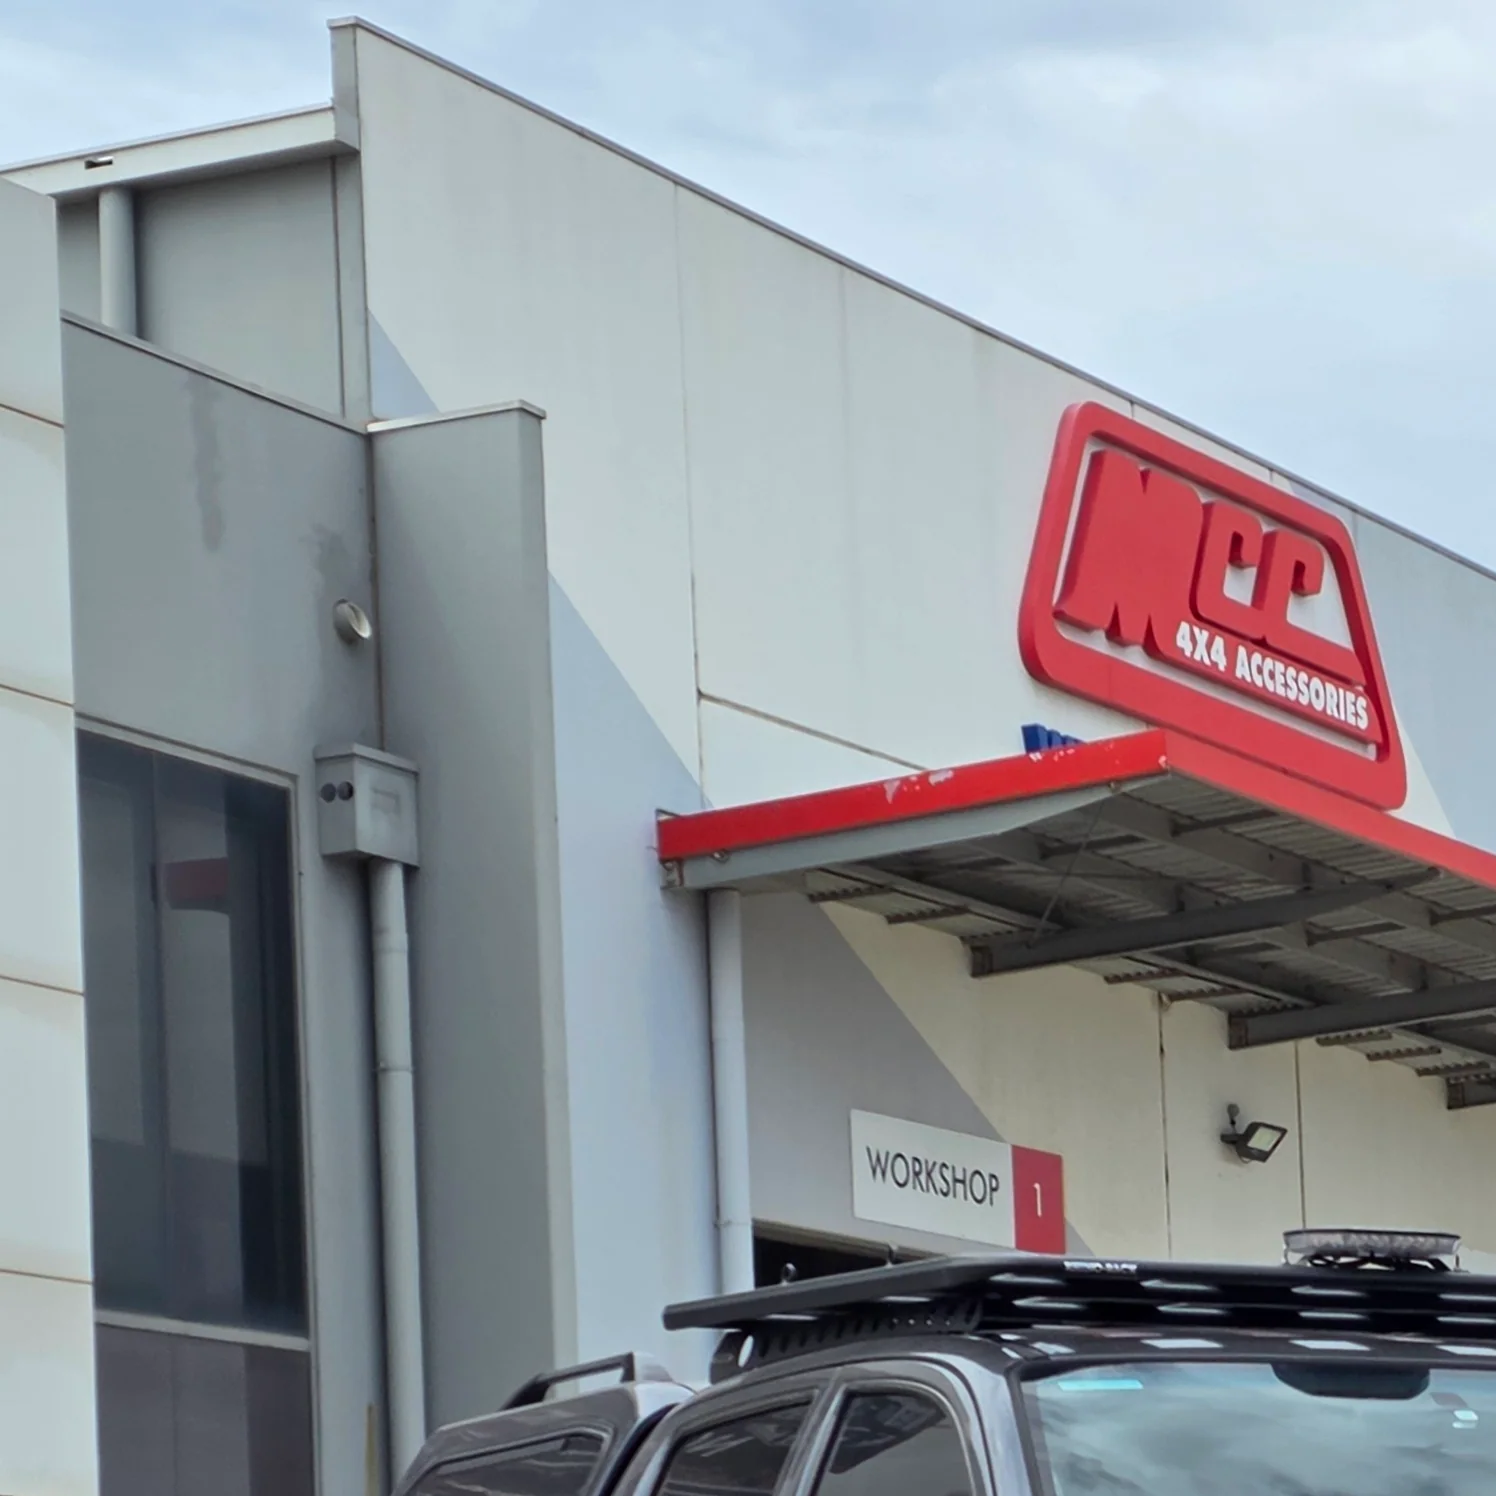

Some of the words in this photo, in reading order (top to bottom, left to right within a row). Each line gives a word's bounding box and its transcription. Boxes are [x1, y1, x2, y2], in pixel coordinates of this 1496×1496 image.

[1176, 621, 1227, 673] 4X4
[1235, 645, 1369, 731] ACCESSORIES
[866, 1146, 1000, 1207] WORKSHOP
[1033, 1182, 1042, 1217] 1
